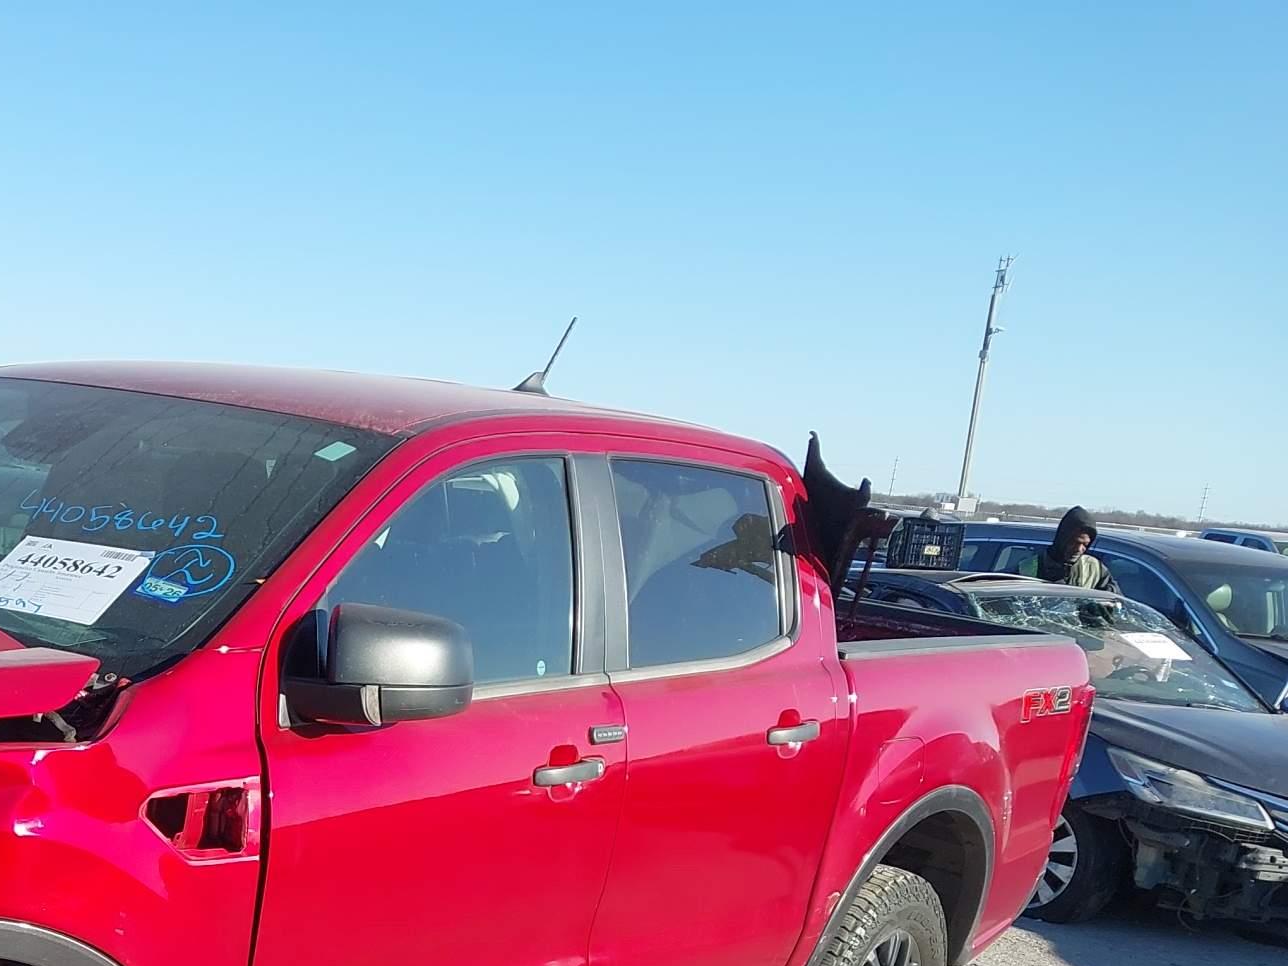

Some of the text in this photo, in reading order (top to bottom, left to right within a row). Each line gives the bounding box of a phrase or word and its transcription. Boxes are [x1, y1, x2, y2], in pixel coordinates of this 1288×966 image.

[20, 489, 224, 540] 44058642
[17, 552, 123, 579] 44058642
[1020, 686, 1072, 723] FX2
